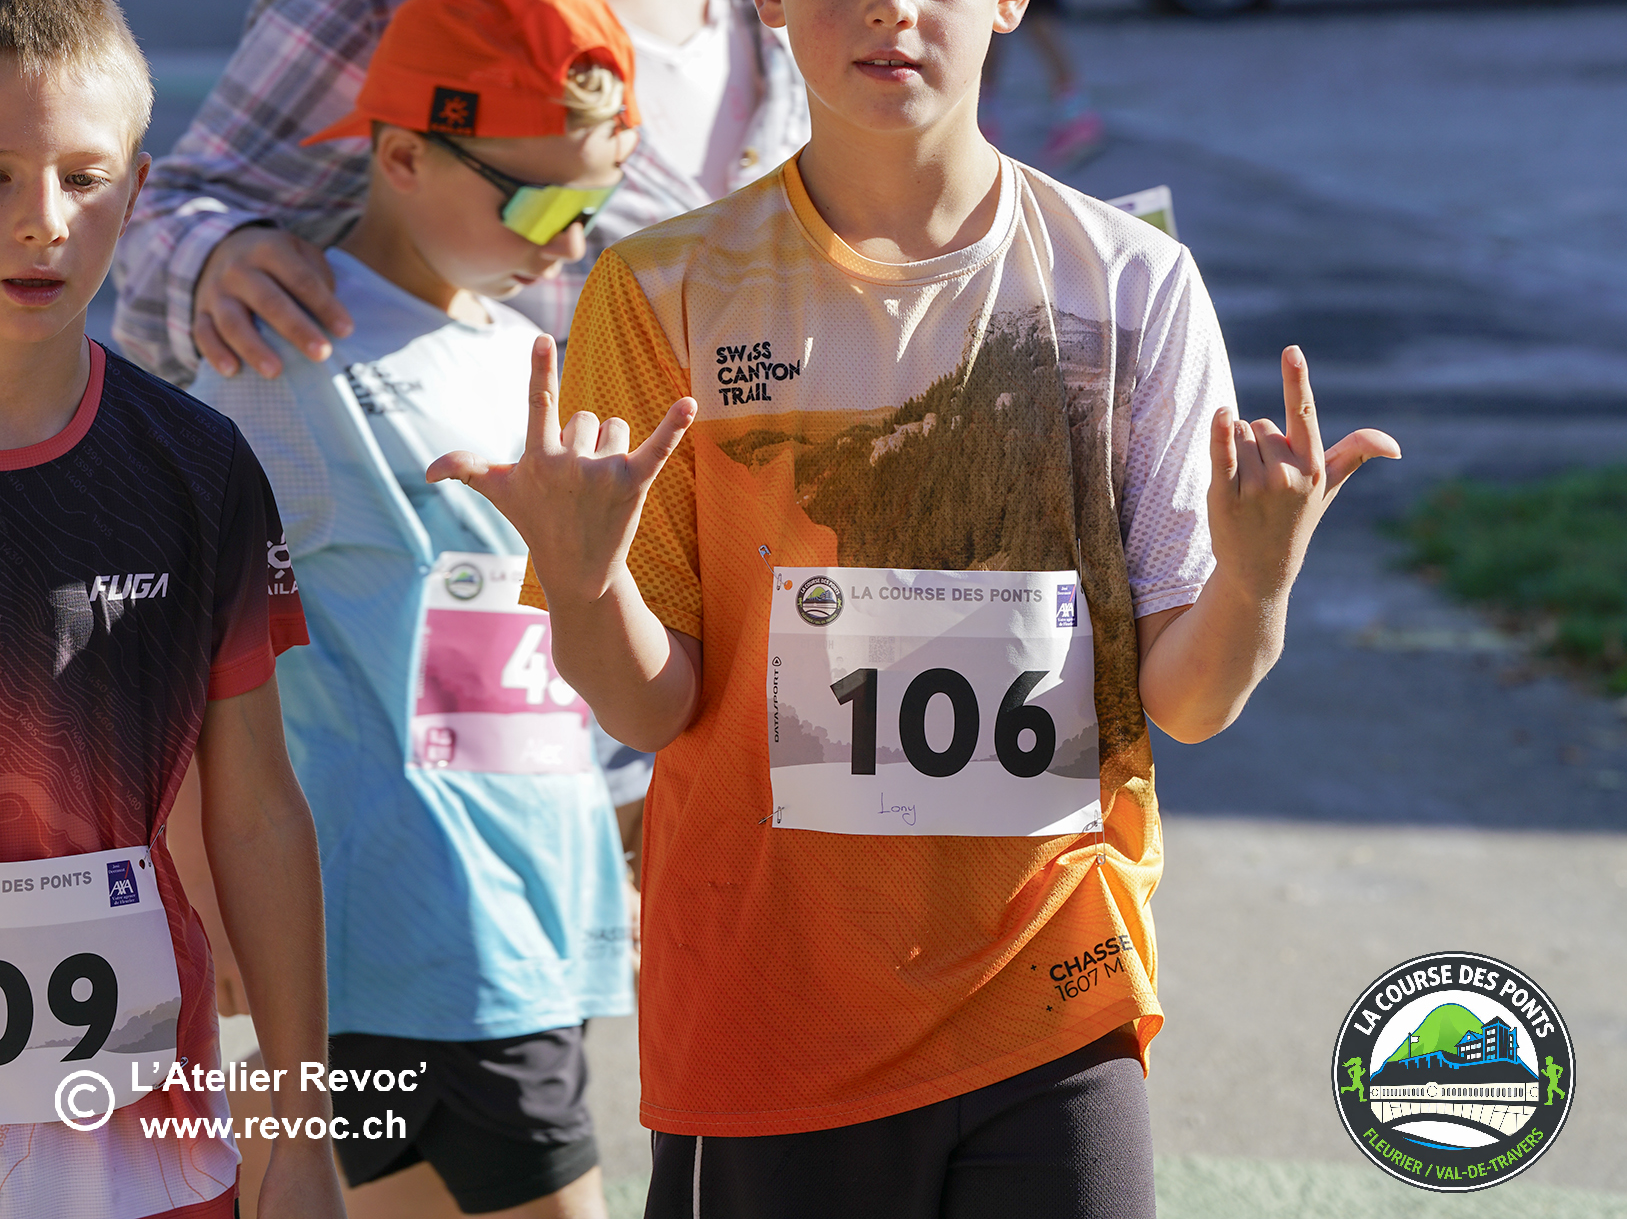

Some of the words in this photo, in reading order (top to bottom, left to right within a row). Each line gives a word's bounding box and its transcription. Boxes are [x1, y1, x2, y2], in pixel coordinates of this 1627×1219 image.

[717, 359, 800, 385] CANYON
[719, 383, 771, 406] TRAIL
[73, 454, 95, 478] 1395
[82, 443, 103, 467] 1390
[64, 470, 88, 494] 1400
[190, 481, 212, 502] 1375
[92, 513, 114, 537] 1405
[90, 572, 169, 602] FUGA
[851, 586, 873, 600] LA
[879, 586, 946, 601] COURSE
[951, 588, 984, 602] DES
[990, 588, 1043, 603] PONTS
[1056, 602, 1075, 618] AXA
[16, 712, 40, 737] 1495
[830, 667, 1056, 778] 106
[69, 762, 84, 791] 1500
[1, 878, 35, 893] DES
[40, 871, 93, 890] PONTS
[110, 879, 134, 896] AXA
[1054, 967, 1098, 1001] 1607
[1103, 957, 1124, 978] M
